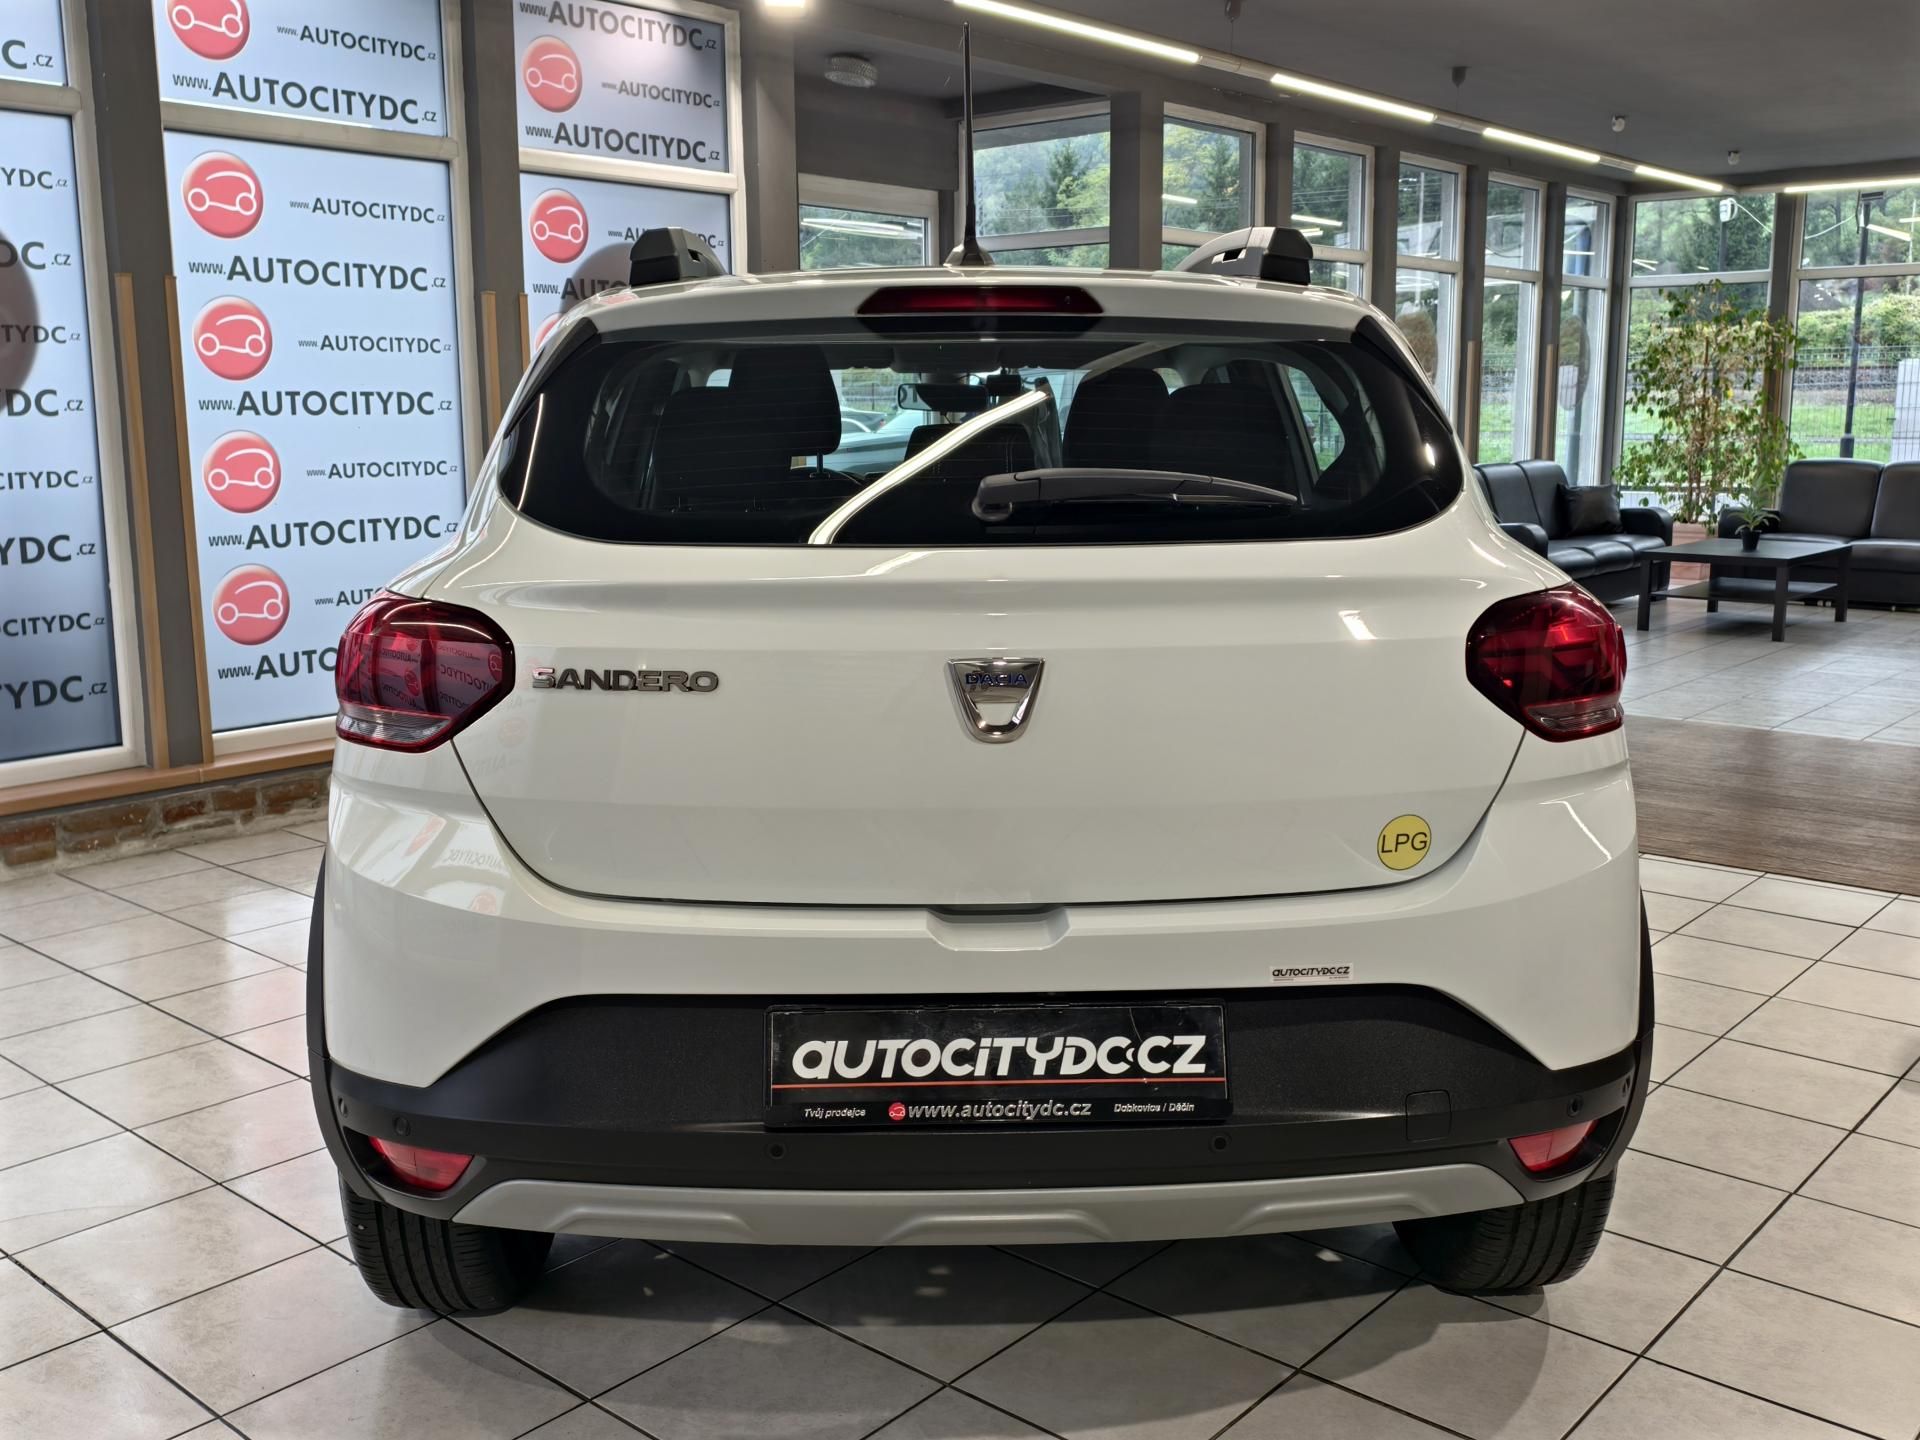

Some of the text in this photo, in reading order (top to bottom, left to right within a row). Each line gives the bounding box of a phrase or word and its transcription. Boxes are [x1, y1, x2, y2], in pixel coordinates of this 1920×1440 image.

[519, 1, 717, 50] www.AUTOCITYDC.cz
[276, 25, 437, 61] www.AUTOCITYDC.cz
[172, 72, 438, 124] www.AUTOCITYDC.cz
[601, 79, 720, 108] www.AUTOCITYDC.cz
[525, 122, 720, 162] www.AUTOCITYDC.cz
[289, 197, 446, 224] www.AUTOCITYDC.cz
[188, 256, 446, 292] www.AUTOCITYDC.cz
[297, 335, 452, 355] www.AUTOCITYDC.cz
[0, 388, 84, 417] DC.cz
[198, 390, 453, 417] www.AUTOCITYDC.cz
[305, 460, 459, 480] www.AUTOCITYDC.cz
[208, 514, 459, 550] www.AUTOCITYDC.cz
[314, 587, 383, 607] www.AUT
[0, 612, 106, 638] CITYDC.cz
[0, 675, 109, 710] YDC.cz
[532, 667, 719, 692] SANDERO
[965, 672, 1027, 686] DACIA
[1380, 831, 1428, 854] LPG
[825, 1107, 866, 1119] prodejce
[908, 1100, 1092, 1120] www.autocitydc.cz
